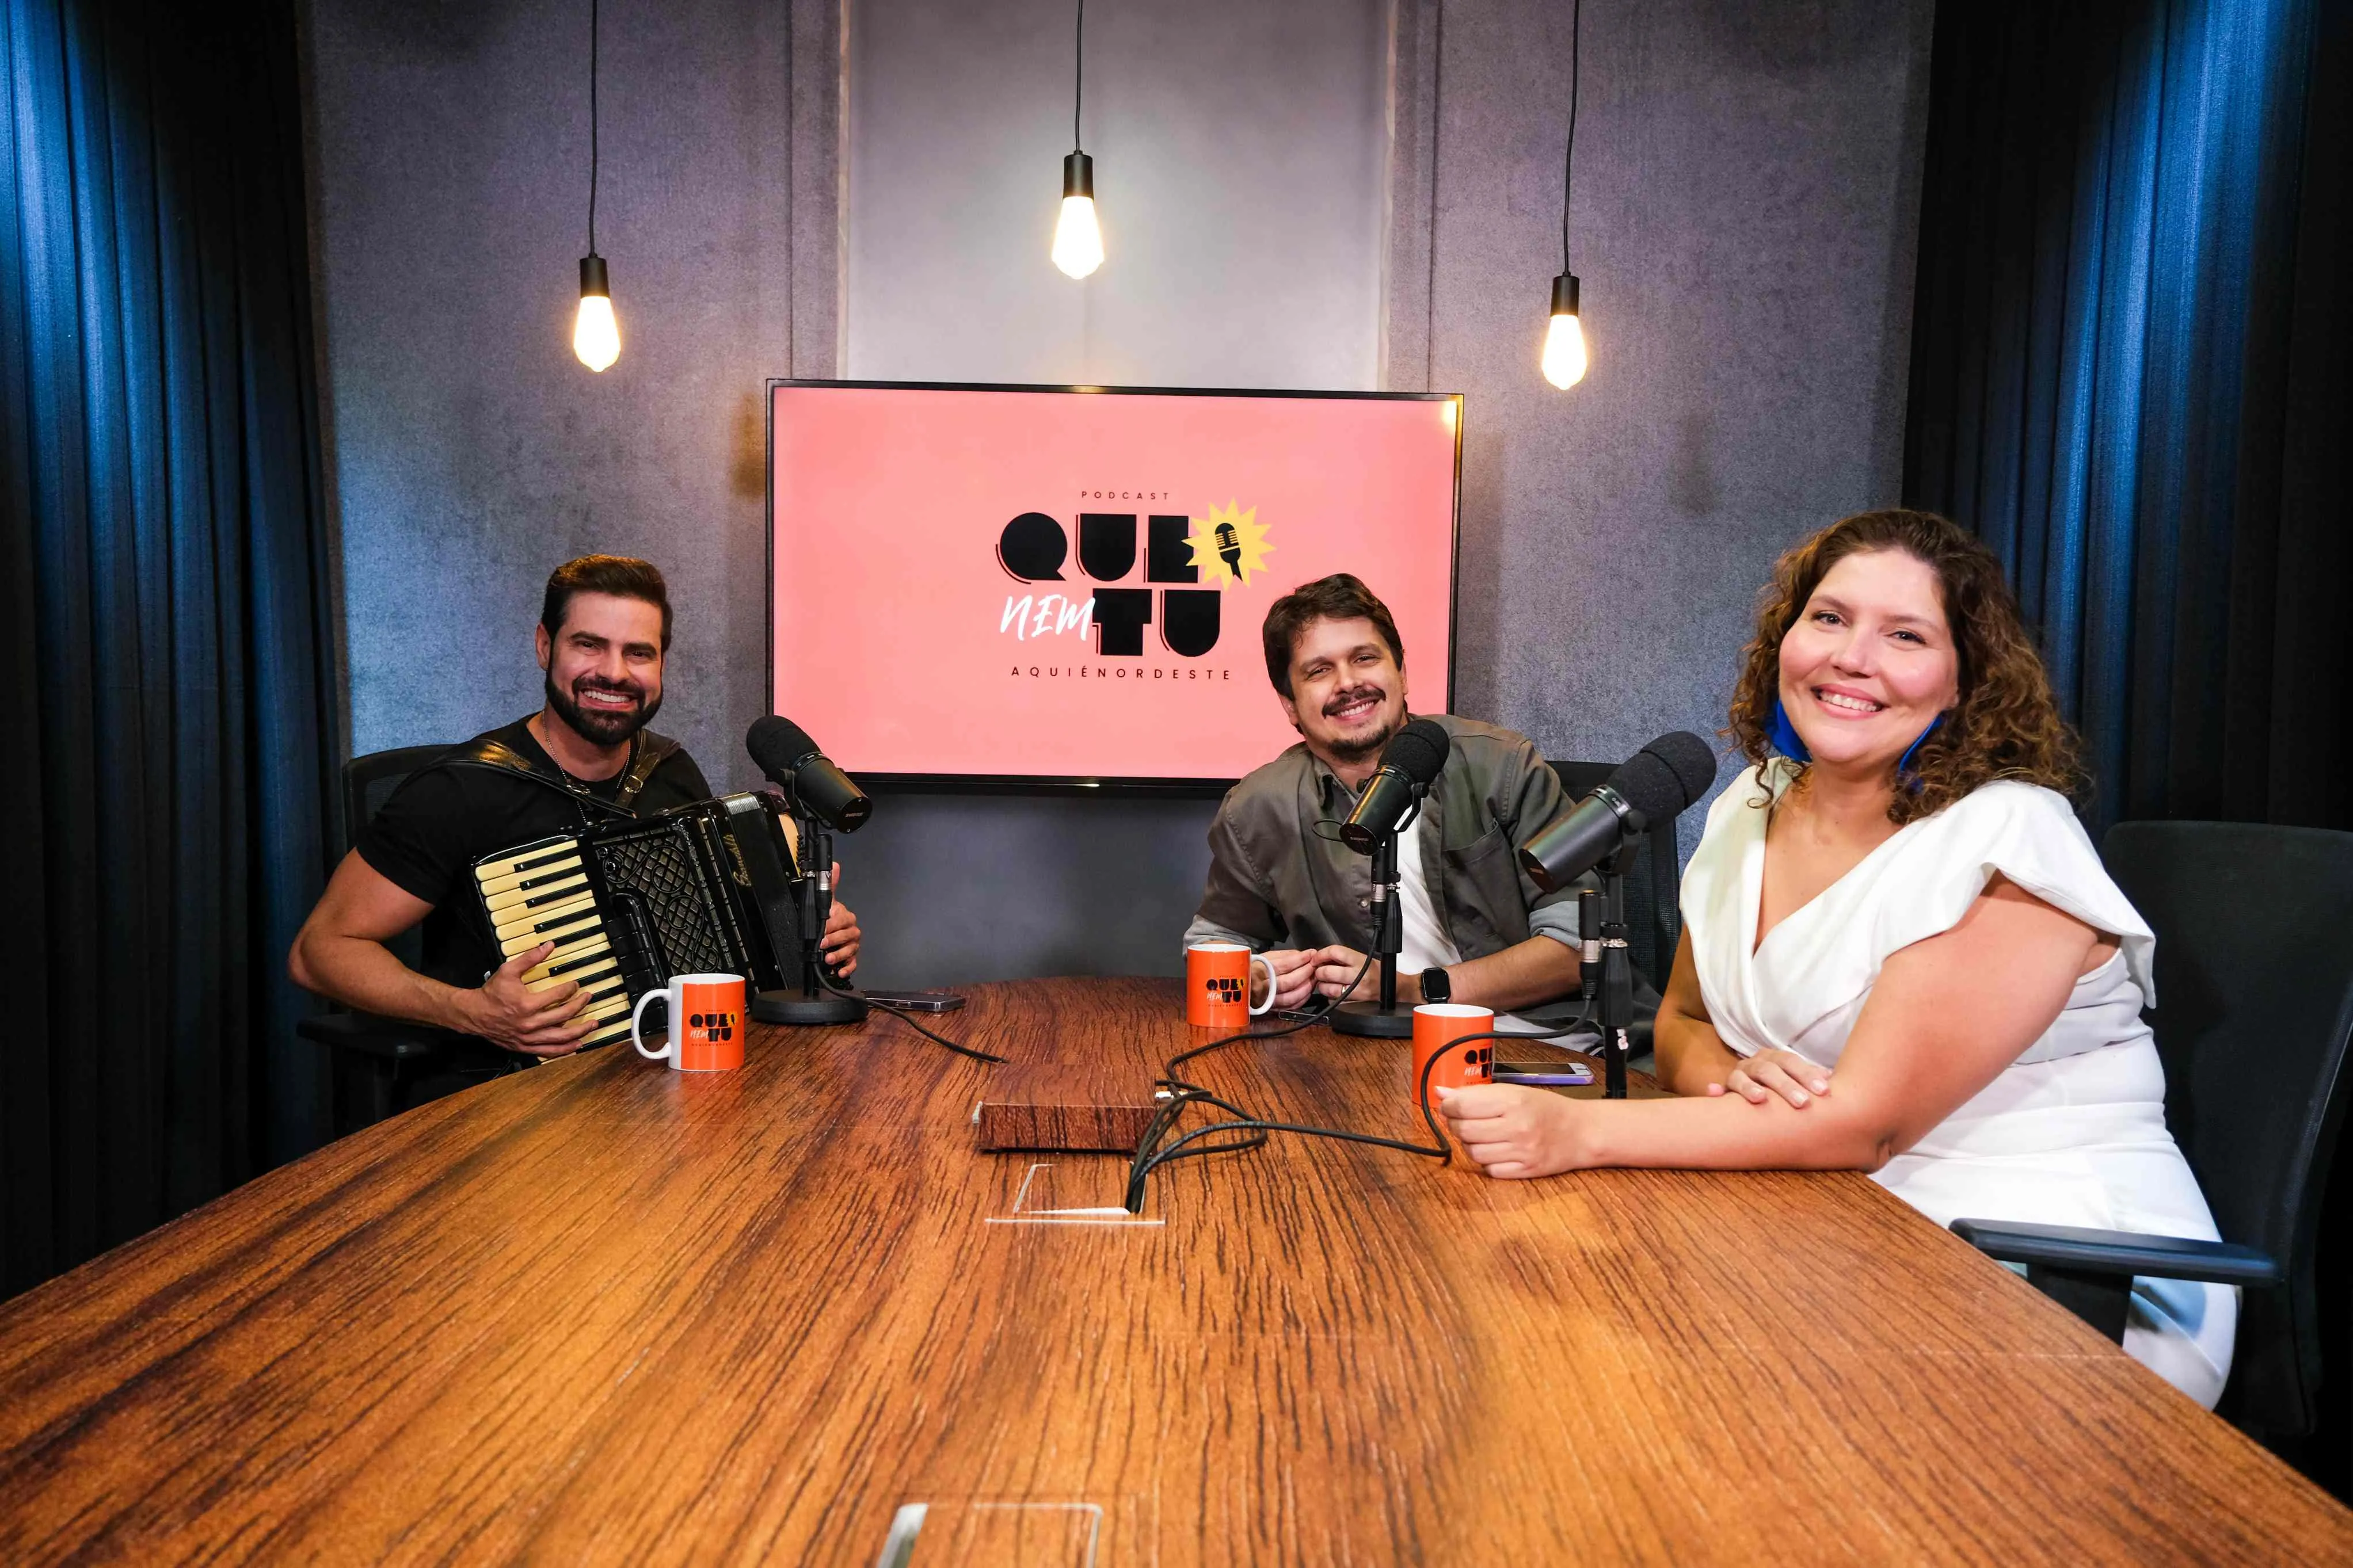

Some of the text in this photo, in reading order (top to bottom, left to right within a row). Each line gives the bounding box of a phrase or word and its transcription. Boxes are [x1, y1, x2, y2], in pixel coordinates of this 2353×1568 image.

[1082, 491, 1169, 500] PODCAST
[996, 512, 1198, 585] QUE
[999, 587, 1221, 658] NEM TU
[1206, 978, 1239, 991] QUE
[1221, 990, 1242, 1003] TU
[690, 1013, 729, 1028] QUE
[707, 1027, 732, 1042] TU
